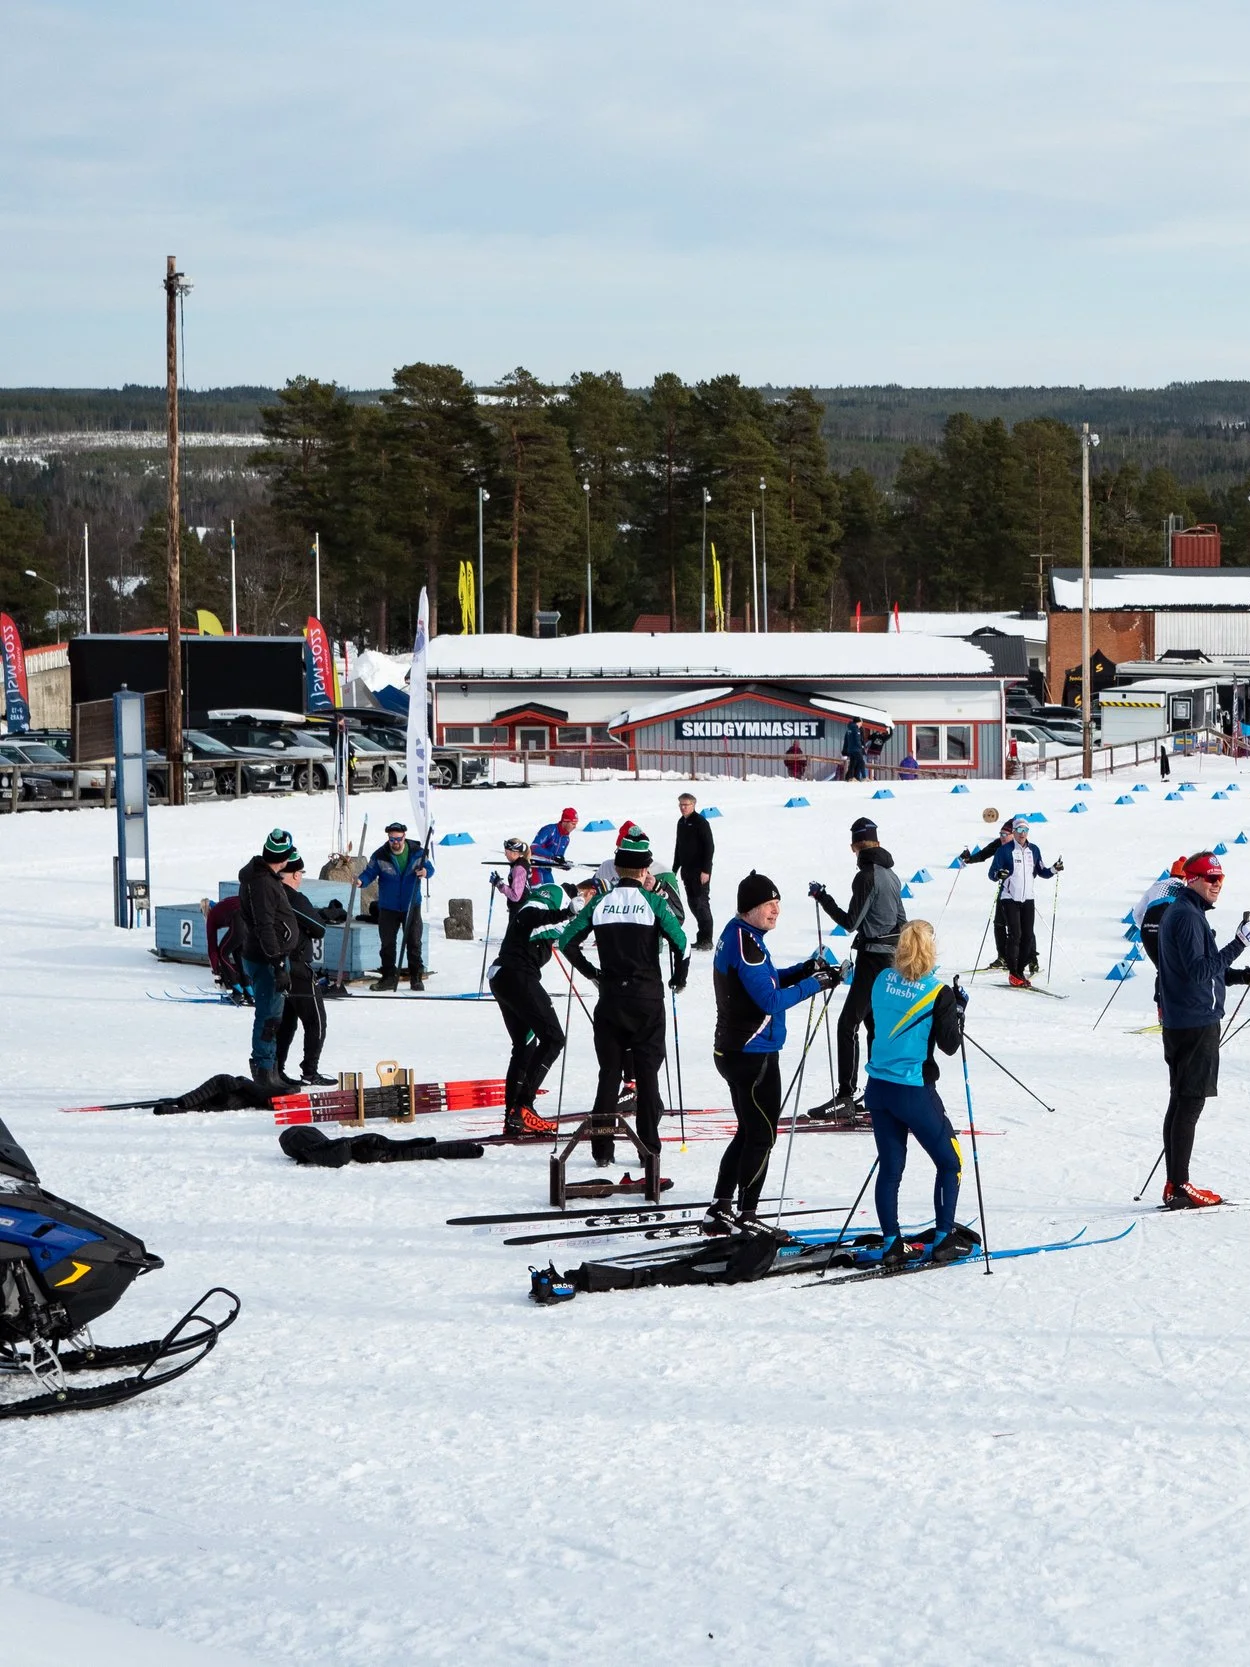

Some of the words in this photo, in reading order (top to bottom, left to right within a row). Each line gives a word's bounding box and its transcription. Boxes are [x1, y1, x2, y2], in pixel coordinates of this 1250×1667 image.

[682, 721, 819, 737] SKIDGYMNASIET
[602, 904, 630, 914] FALU
[632, 904, 645, 914] IK
[182, 921, 192, 945] 2
[312, 938, 323, 960] 3
